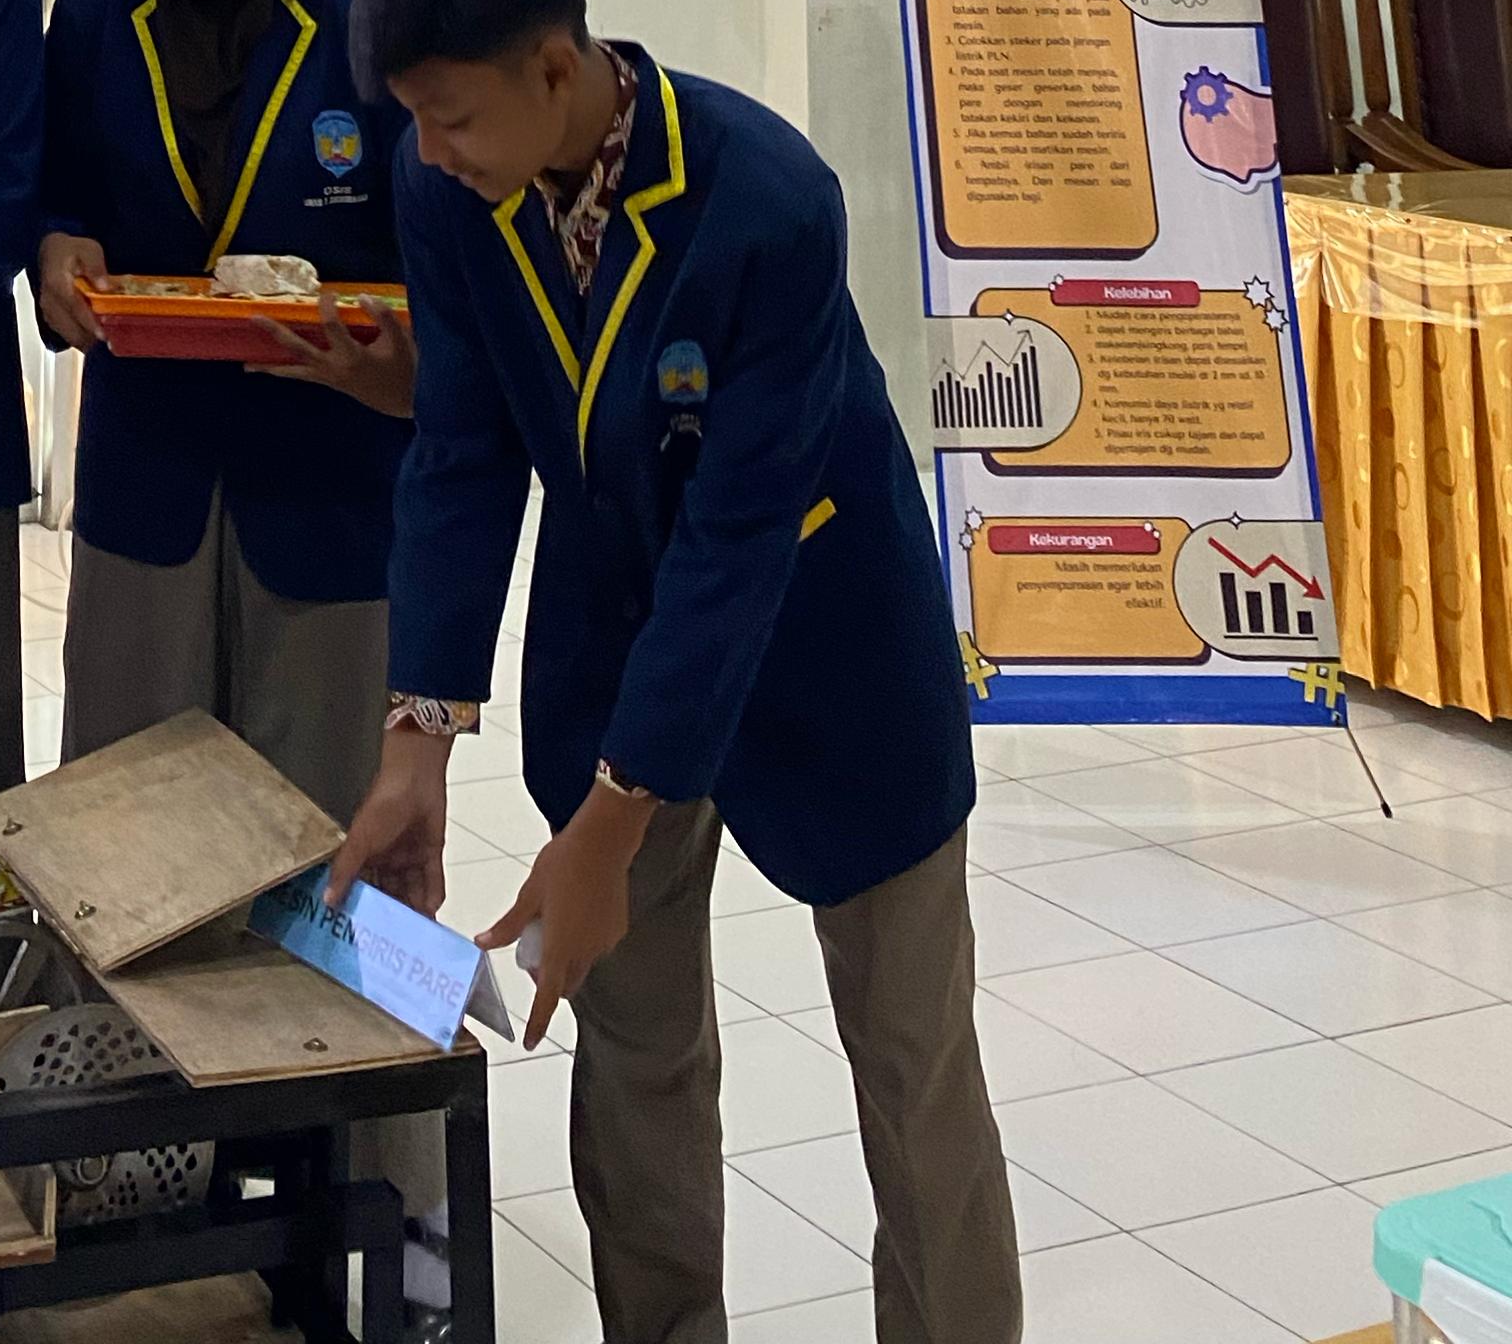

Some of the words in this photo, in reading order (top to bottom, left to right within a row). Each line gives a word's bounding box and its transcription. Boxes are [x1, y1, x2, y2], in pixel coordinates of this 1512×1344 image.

[996, 6, 1028, 15] bahan
[1087, 7, 1111, 17] pada
[1009, 37, 1041, 45] steker
[1046, 37, 1070, 47] pada
[961, 67, 985, 76] Pada
[1092, 84, 1120, 92] bahan
[1004, 99, 1042, 110] dengan
[1066, 100, 1122, 110] mendorong
[1033, 115, 1053, 123] dan
[966, 129, 986, 137] Jika
[990, 130, 1022, 138] semua
[1026, 130, 1058, 138] bahan
[1062, 130, 1093, 138] sudah
[967, 192, 1019, 203] digunakan
[1103, 286, 1172, 299] Kelebihan
[1029, 533, 1113, 549] Kekurangan
[319, 906, 406, 976] PENGIRIS
[405, 957, 465, 1008] PARE
